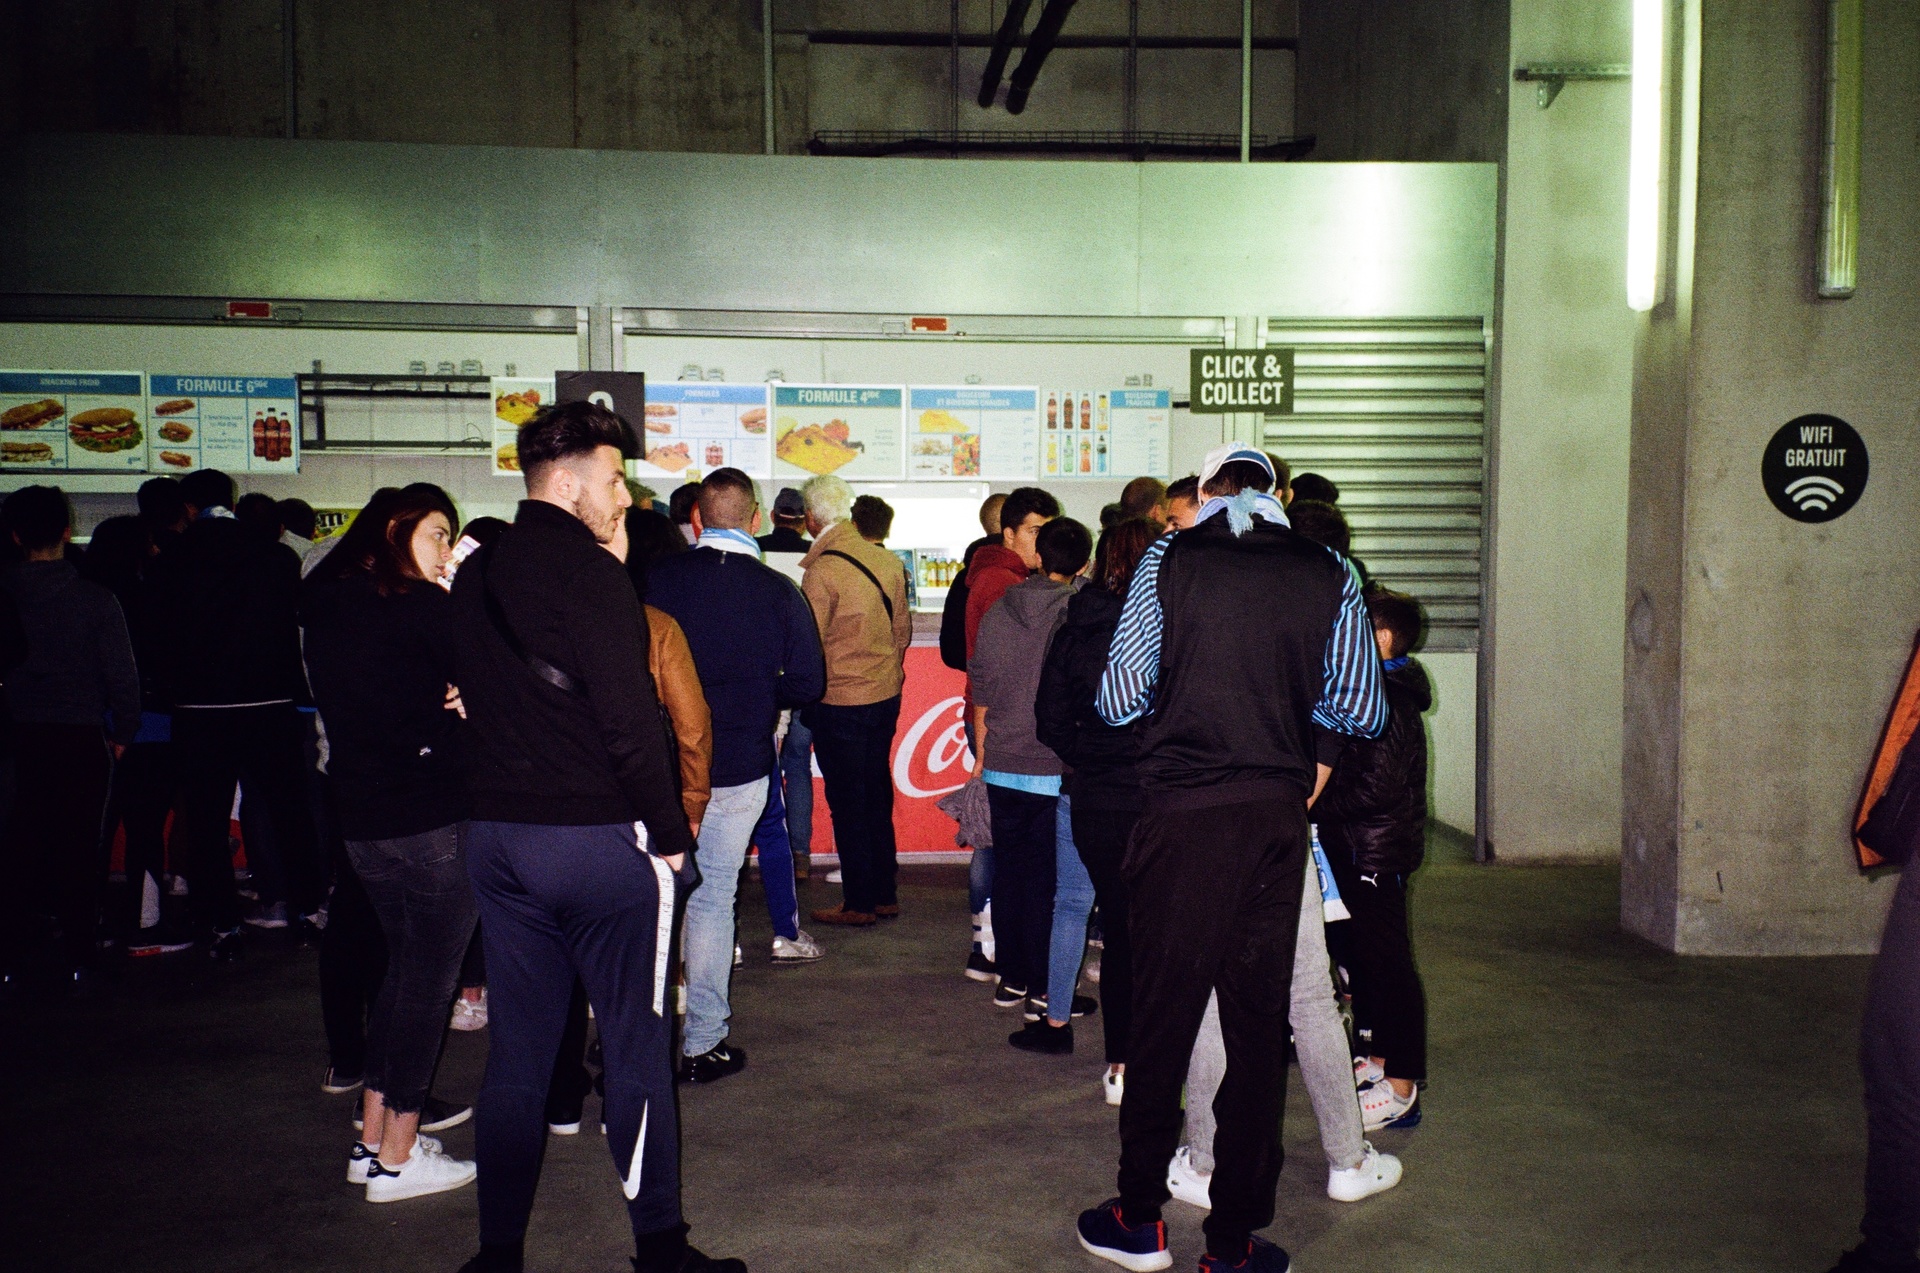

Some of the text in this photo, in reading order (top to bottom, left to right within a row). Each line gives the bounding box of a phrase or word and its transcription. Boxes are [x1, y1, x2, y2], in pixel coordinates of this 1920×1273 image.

[1201, 354, 1282, 379] CLICK &
[176, 378, 243, 393] FORMULE
[1200, 381, 1284, 406] COLLECT
[798, 389, 858, 404] FORMULE
[1800, 426, 1833, 444] WIFI
[1785, 449, 1847, 467] GRATUIT
